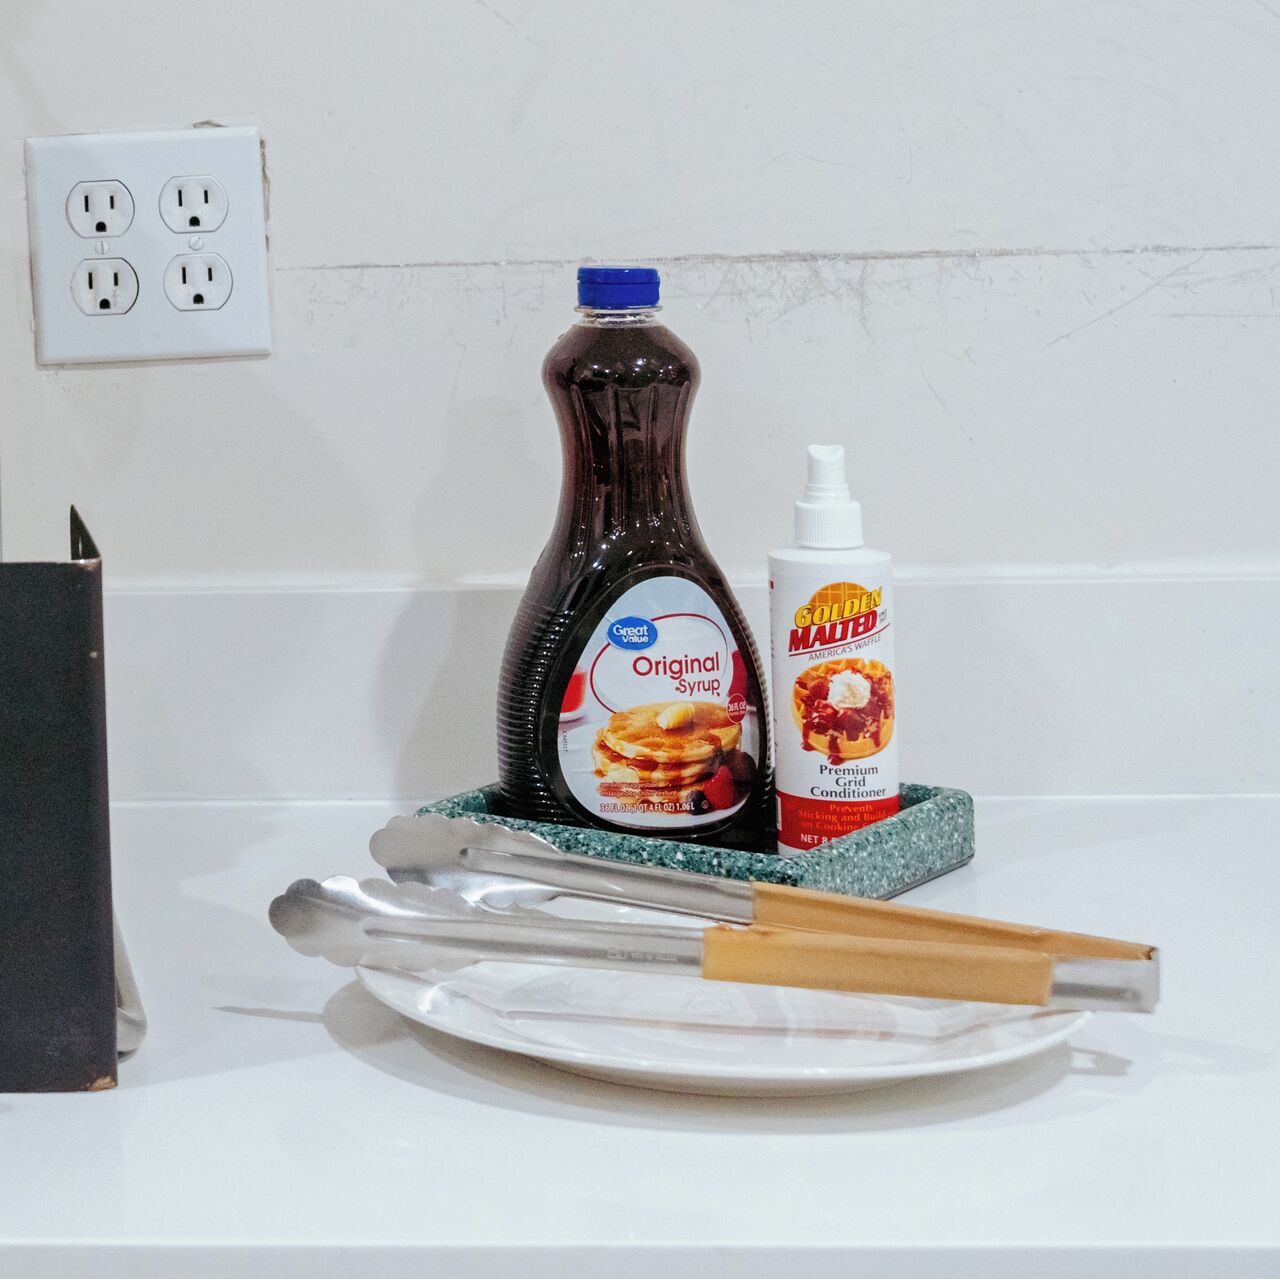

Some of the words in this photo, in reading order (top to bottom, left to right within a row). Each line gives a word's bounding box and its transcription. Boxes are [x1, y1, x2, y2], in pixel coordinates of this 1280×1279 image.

[794, 586, 882, 628] GOLDEN
[612, 624, 649, 637] Great
[789, 609, 878, 652] MALTED
[621, 633, 649, 643] Value
[808, 644, 853, 661] AMERICA'S
[855, 635, 881, 650] WAFFLE
[632, 652, 720, 680] Original
[678, 678, 721, 696] Syrup
[819, 764, 878, 776] Premium
[835, 776, 866, 787] Grid
[810, 786, 886, 798] Conditioner
[600, 803, 609, 812] 36
[610, 803, 620, 812] FL
[620, 803, 630, 812] OZ
[639, 803, 649, 812] QT
[649, 803, 654, 811] 4
[655, 803, 663, 811] FL
[664, 802, 675, 812] OZ)
[830, 804, 873, 813] Prevents
[799, 809, 838, 823] Sticking
[841, 812, 861, 821] and
[800, 833, 819, 844] NET
